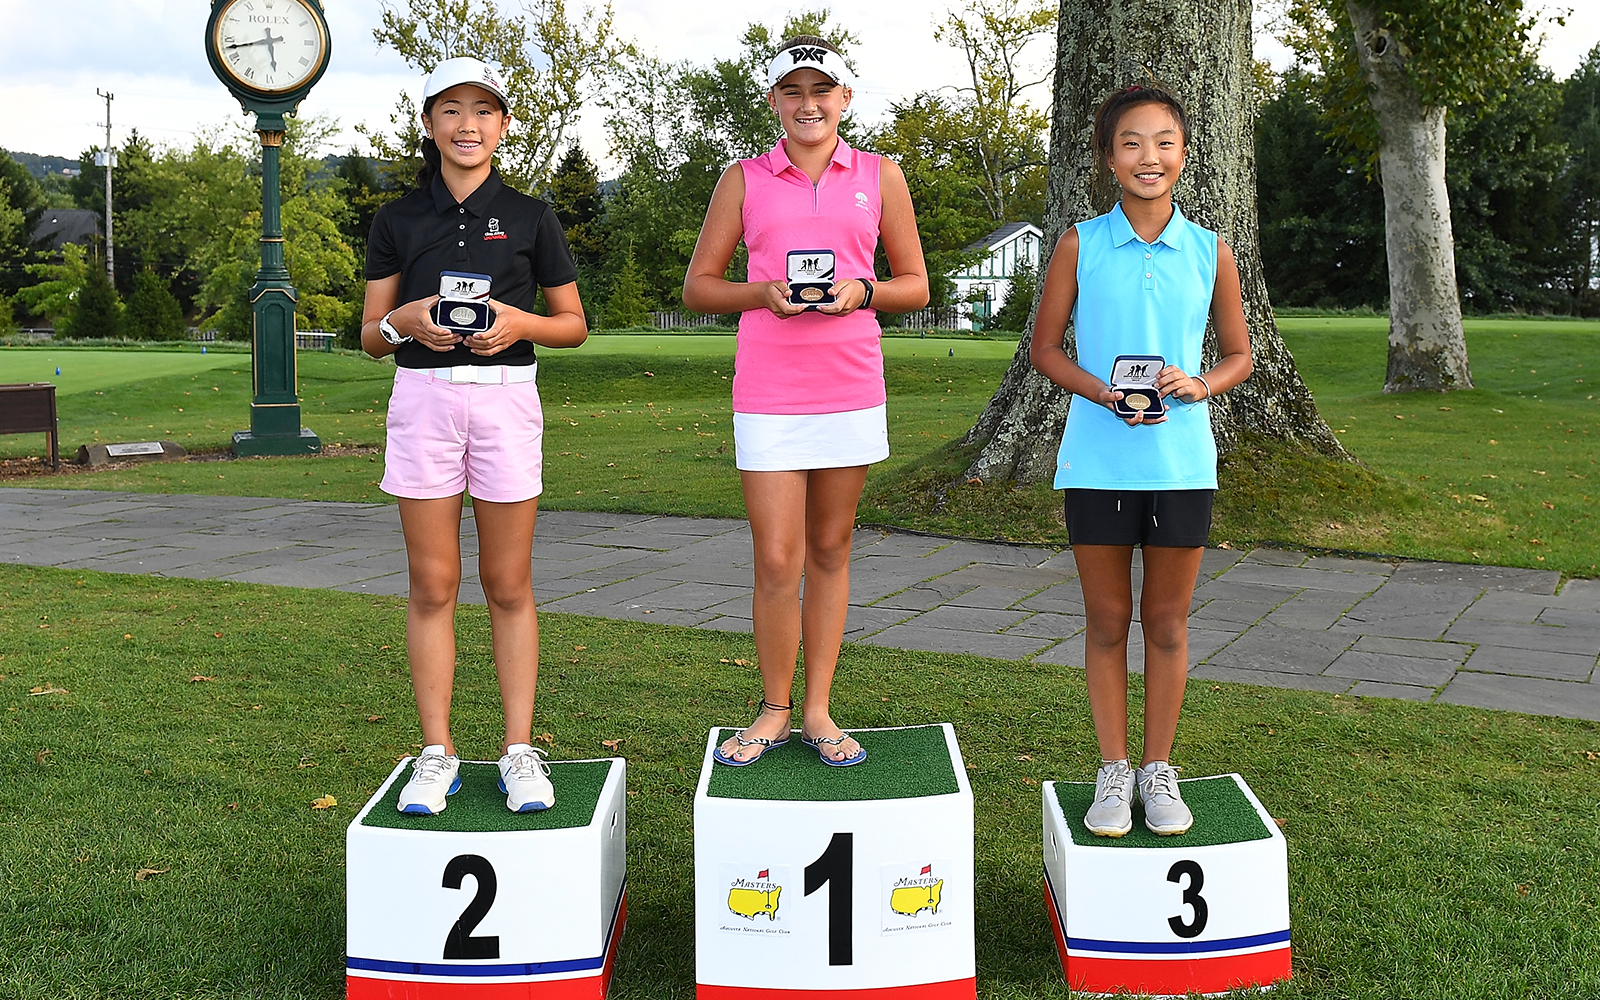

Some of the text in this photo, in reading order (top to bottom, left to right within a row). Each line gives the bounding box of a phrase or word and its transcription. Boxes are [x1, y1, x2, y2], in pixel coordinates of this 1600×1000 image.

[248, 14, 290, 25] ROLEX
[788, 47, 828, 65] PXG
[442, 855, 500, 960] 2
[804, 833, 853, 966] 1
[1167, 860, 1208, 938] 3
